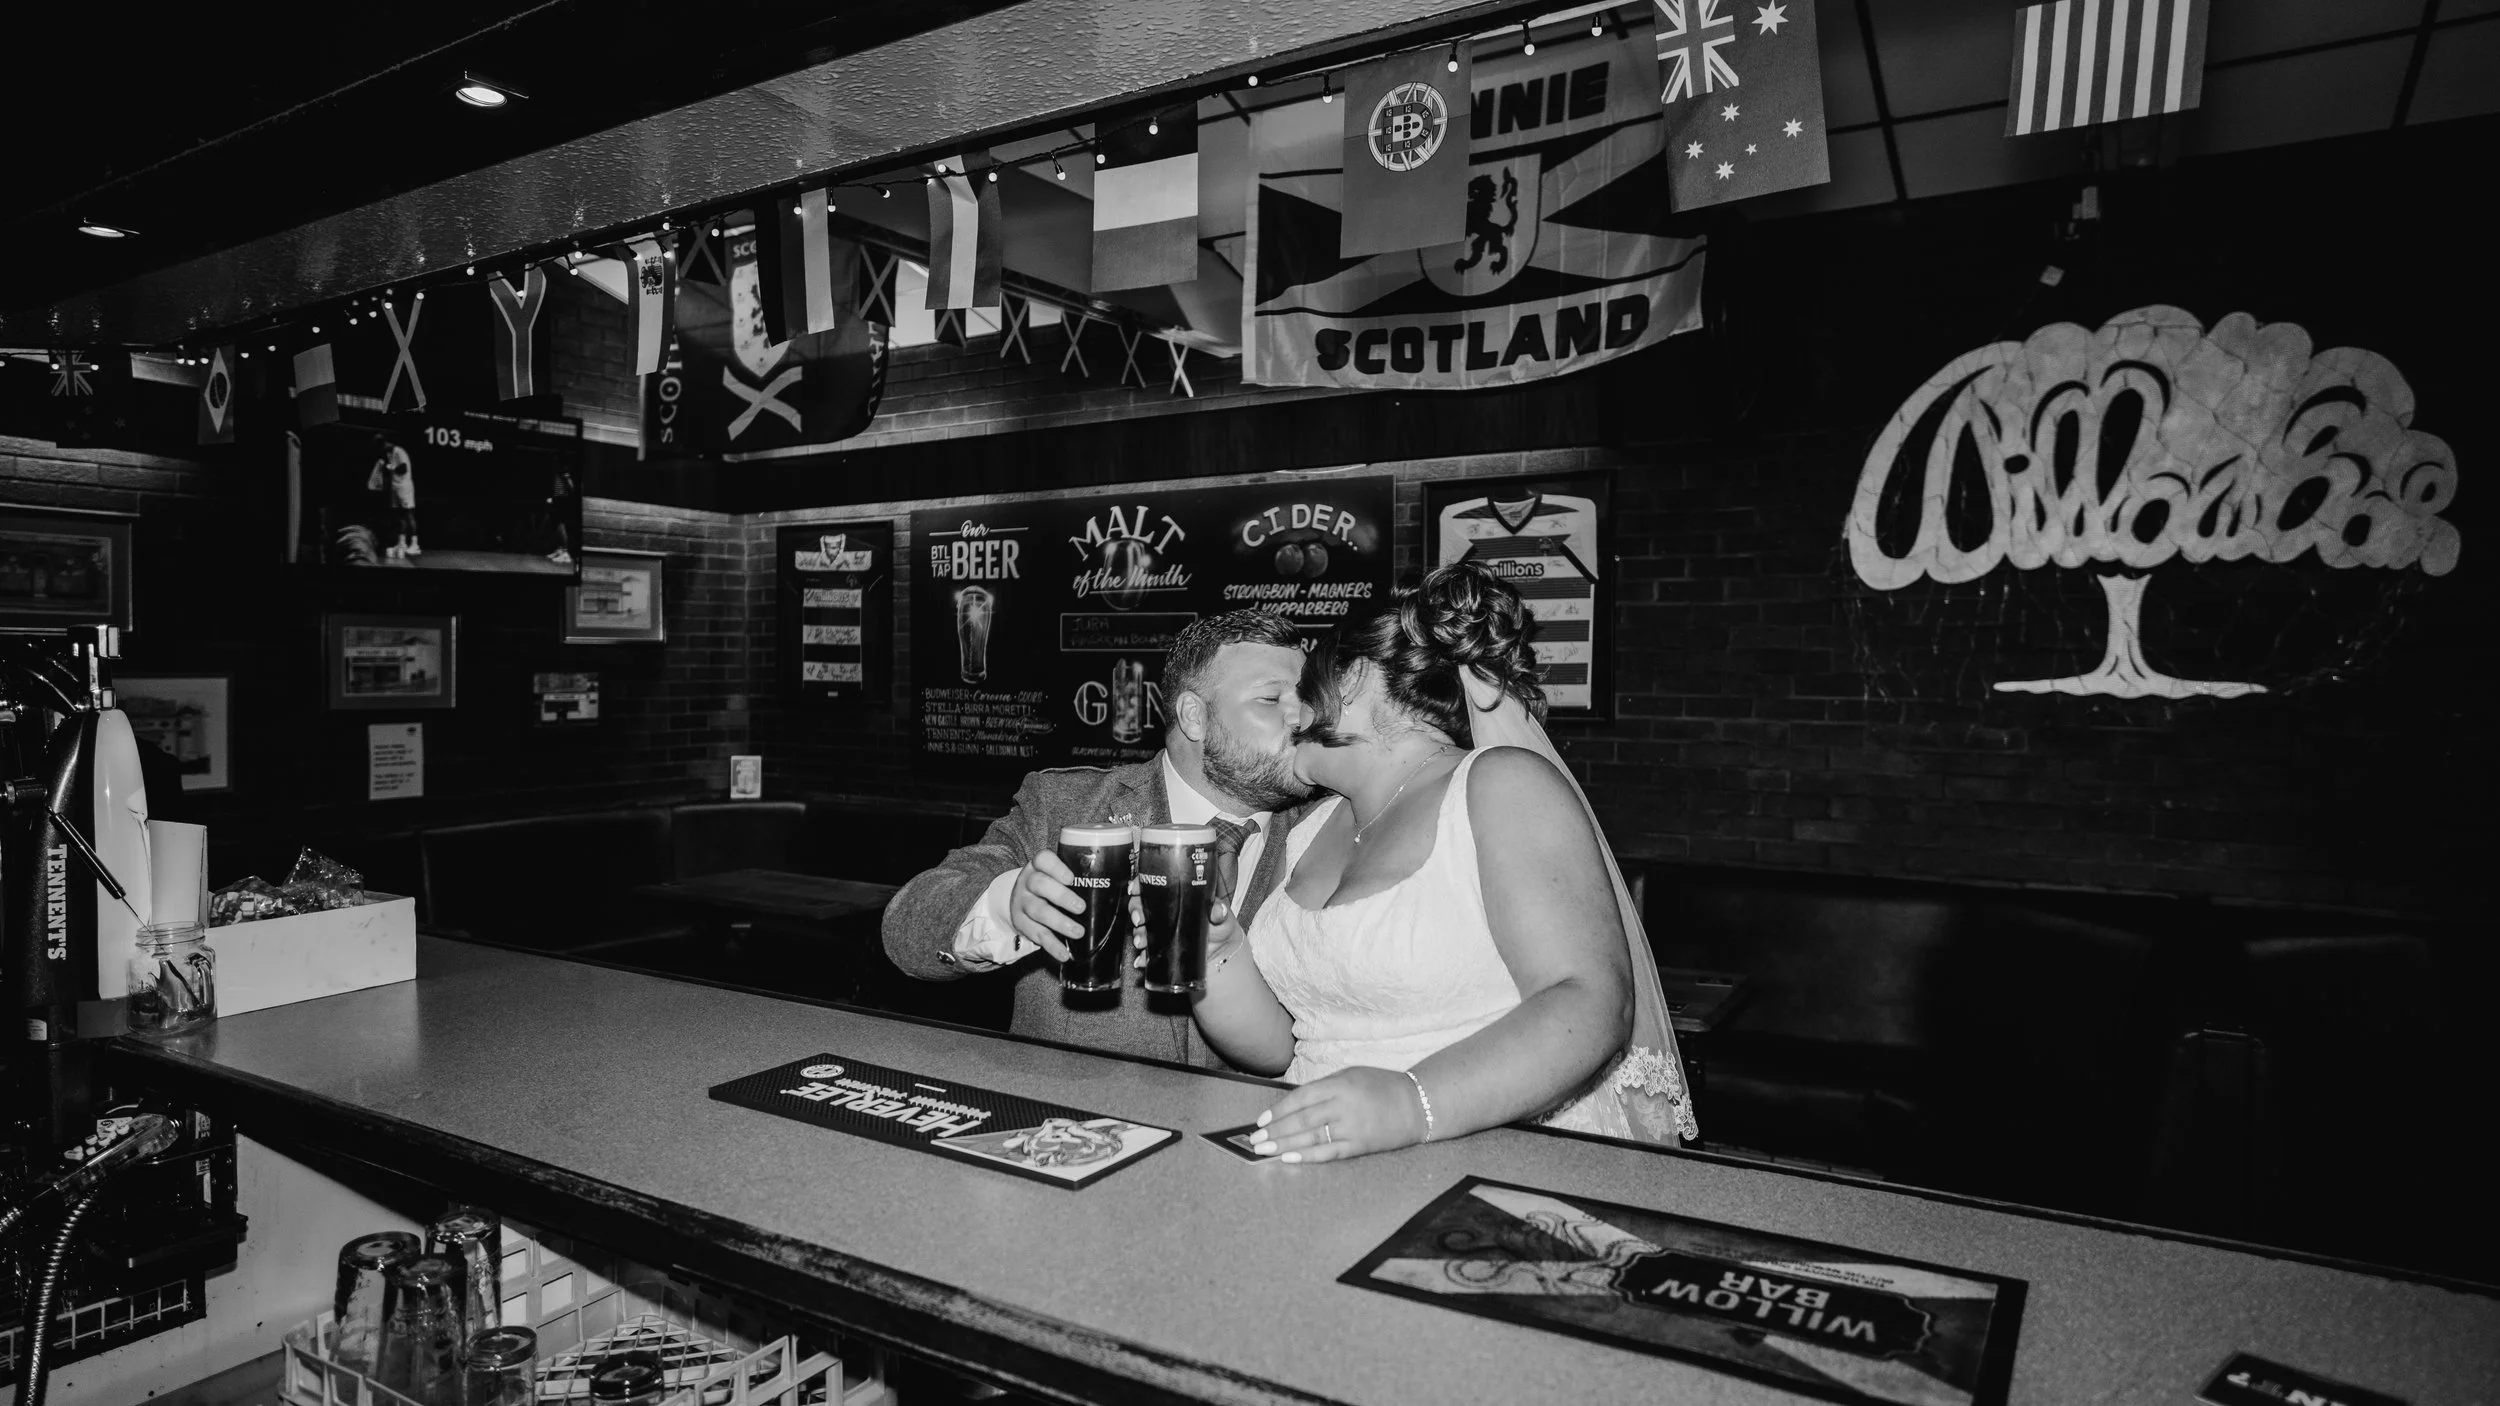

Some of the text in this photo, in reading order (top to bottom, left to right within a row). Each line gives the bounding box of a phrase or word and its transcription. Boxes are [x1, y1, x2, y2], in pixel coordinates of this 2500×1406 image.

[1315, 293, 1650, 375] SCOTLAND
[424, 426, 461, 448] 103
[960, 519, 991, 538] Our
[1069, 505, 1186, 562] MALT
[931, 545, 951, 561] BTL
[931, 563, 951, 578] TAP
[952, 539, 1021, 580] BEER
[1073, 563, 1193, 599] of the Month
[1223, 581, 1374, 600] STRONGBOW MAGNERS
[925, 701, 1031, 717] STELLA BIRRA MORETTI
[47, 843, 69, 961] TENNENT'S
[786, 1081, 984, 1139] HEVERLEE
[1719, 1271, 1831, 1310] BAR
[1651, 1278, 1877, 1343] WILLOW
